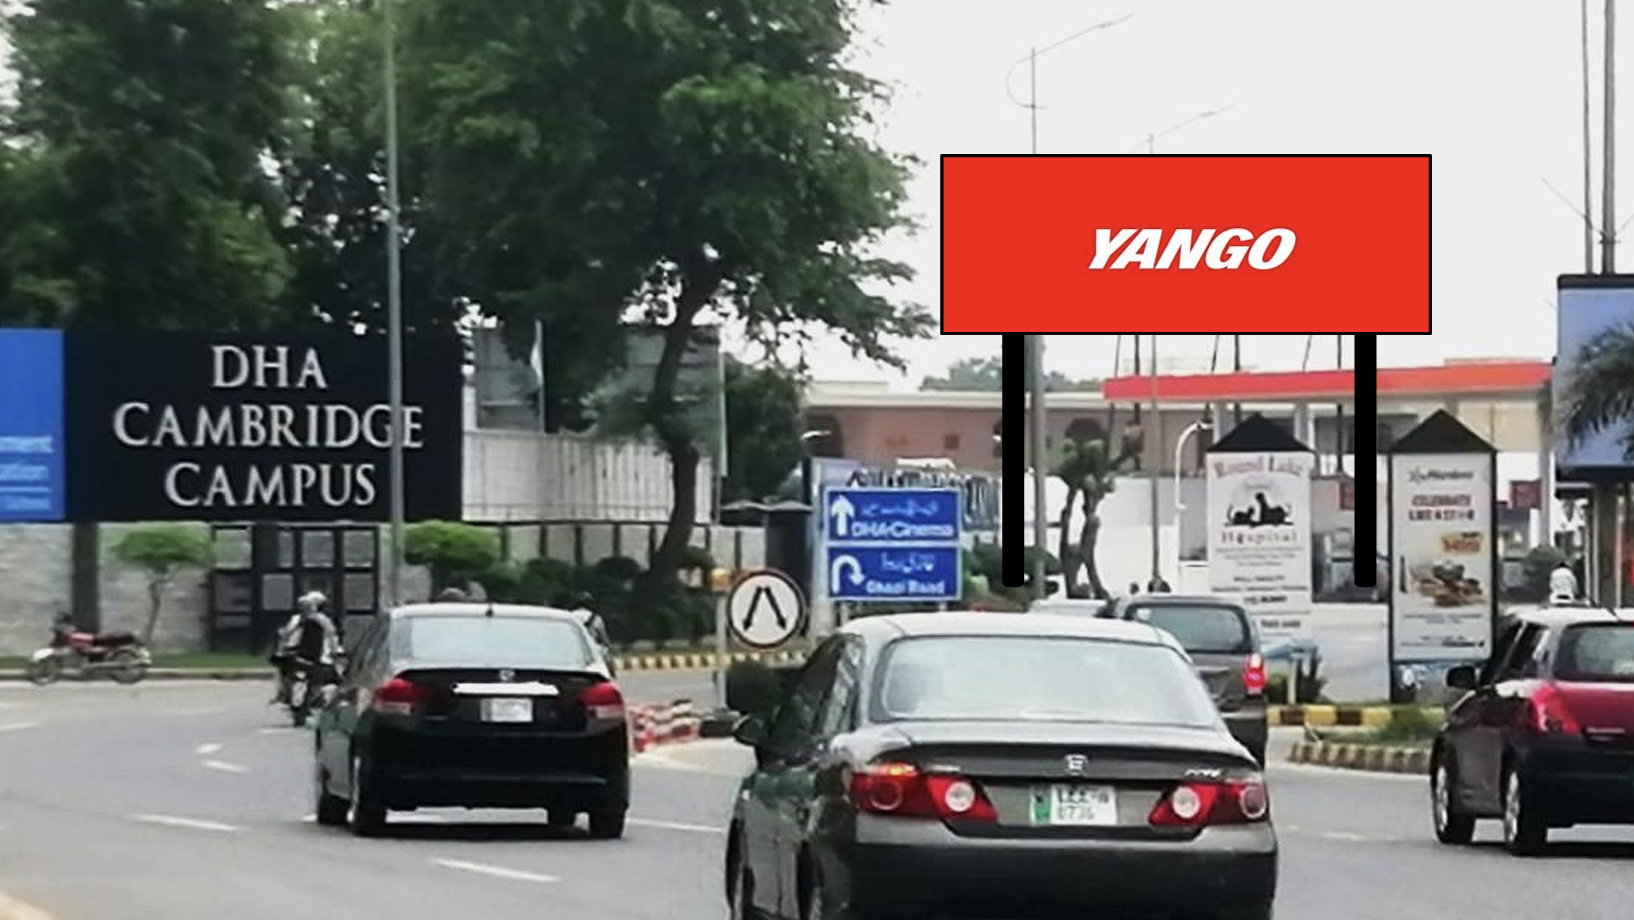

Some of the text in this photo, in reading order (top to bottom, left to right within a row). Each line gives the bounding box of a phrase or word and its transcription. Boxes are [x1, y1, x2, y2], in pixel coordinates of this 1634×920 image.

[1088, 227, 1297, 271] YANGO
[212, 345, 328, 389] DHA
[113, 402, 424, 449] CAMBRIDGE
[164, 462, 377, 507] CAMPUS
[851, 521, 954, 537] DHA Cinema
[908, 579, 945, 594] Road
